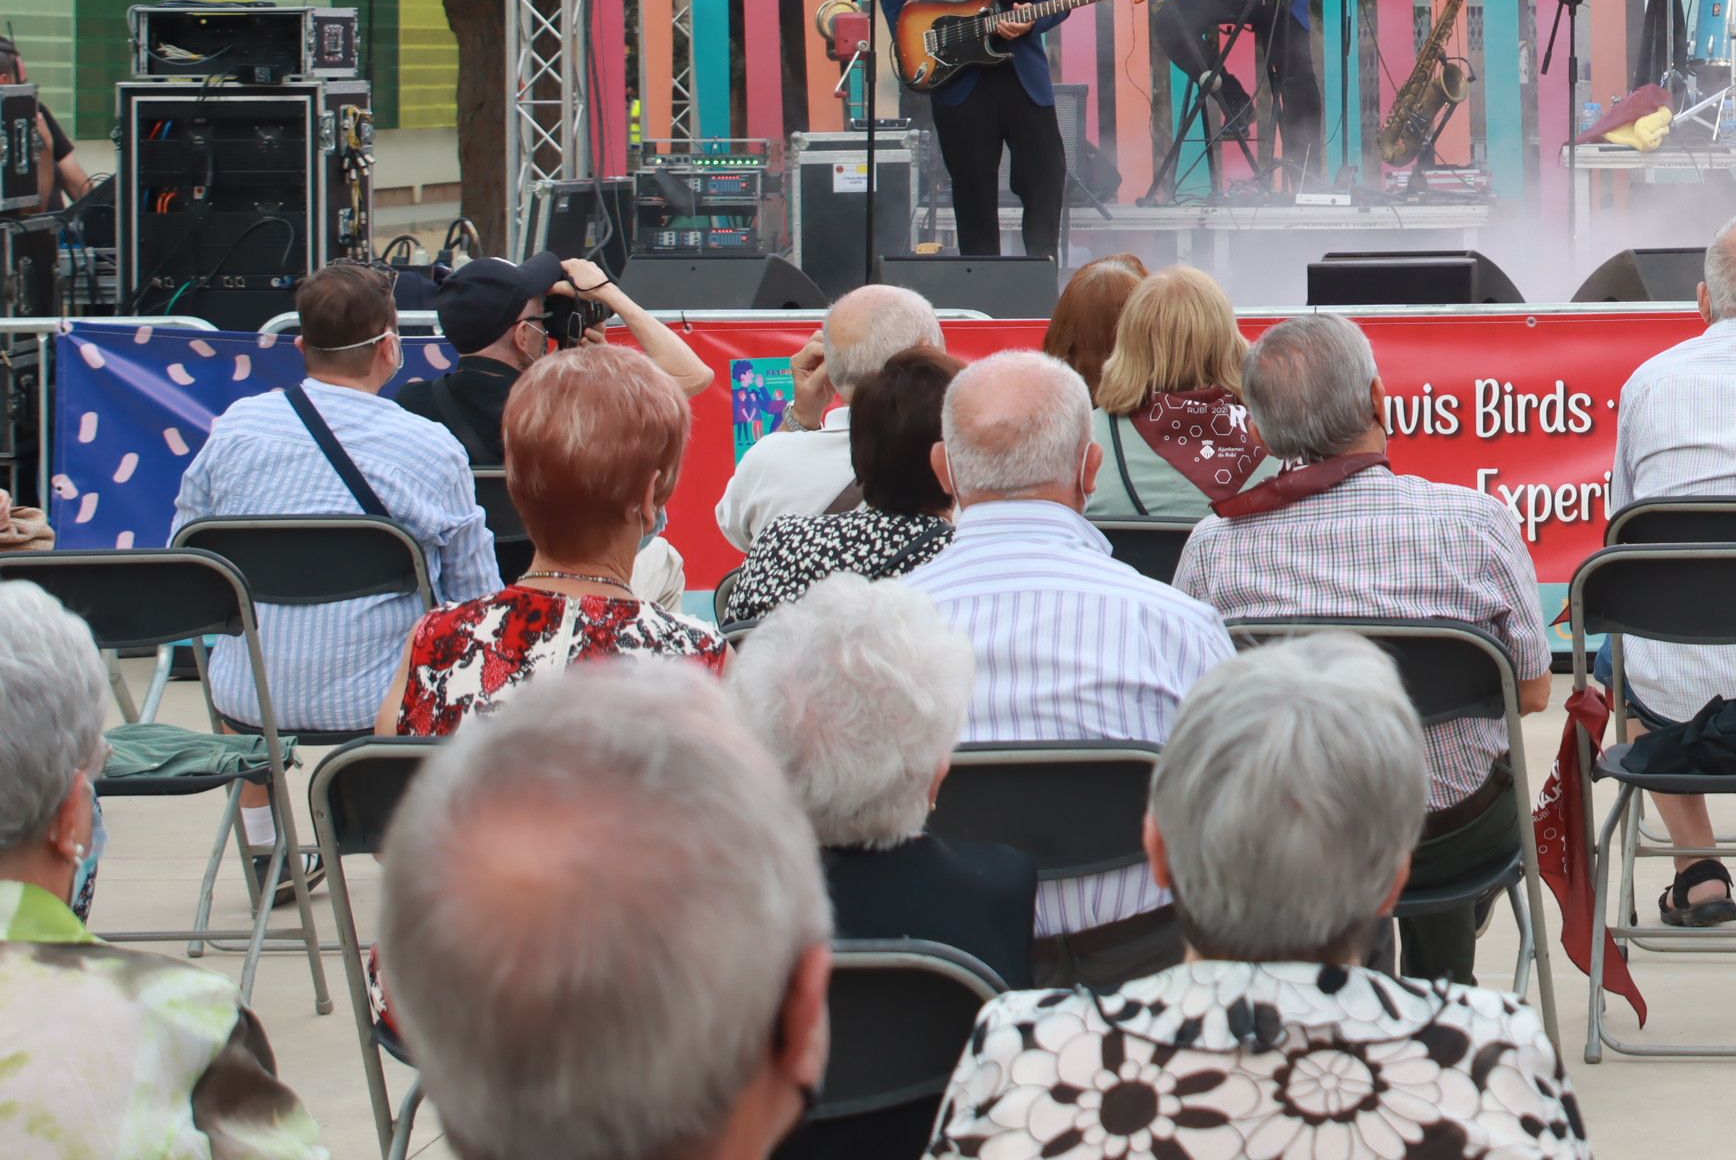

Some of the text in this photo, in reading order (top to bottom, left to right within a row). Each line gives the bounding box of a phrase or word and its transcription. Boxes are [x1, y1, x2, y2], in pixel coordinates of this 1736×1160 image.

[1211, 406, 1229, 414] 2021
[1474, 377, 1593, 438] Birds
[1476, 467, 1612, 543] xperi
